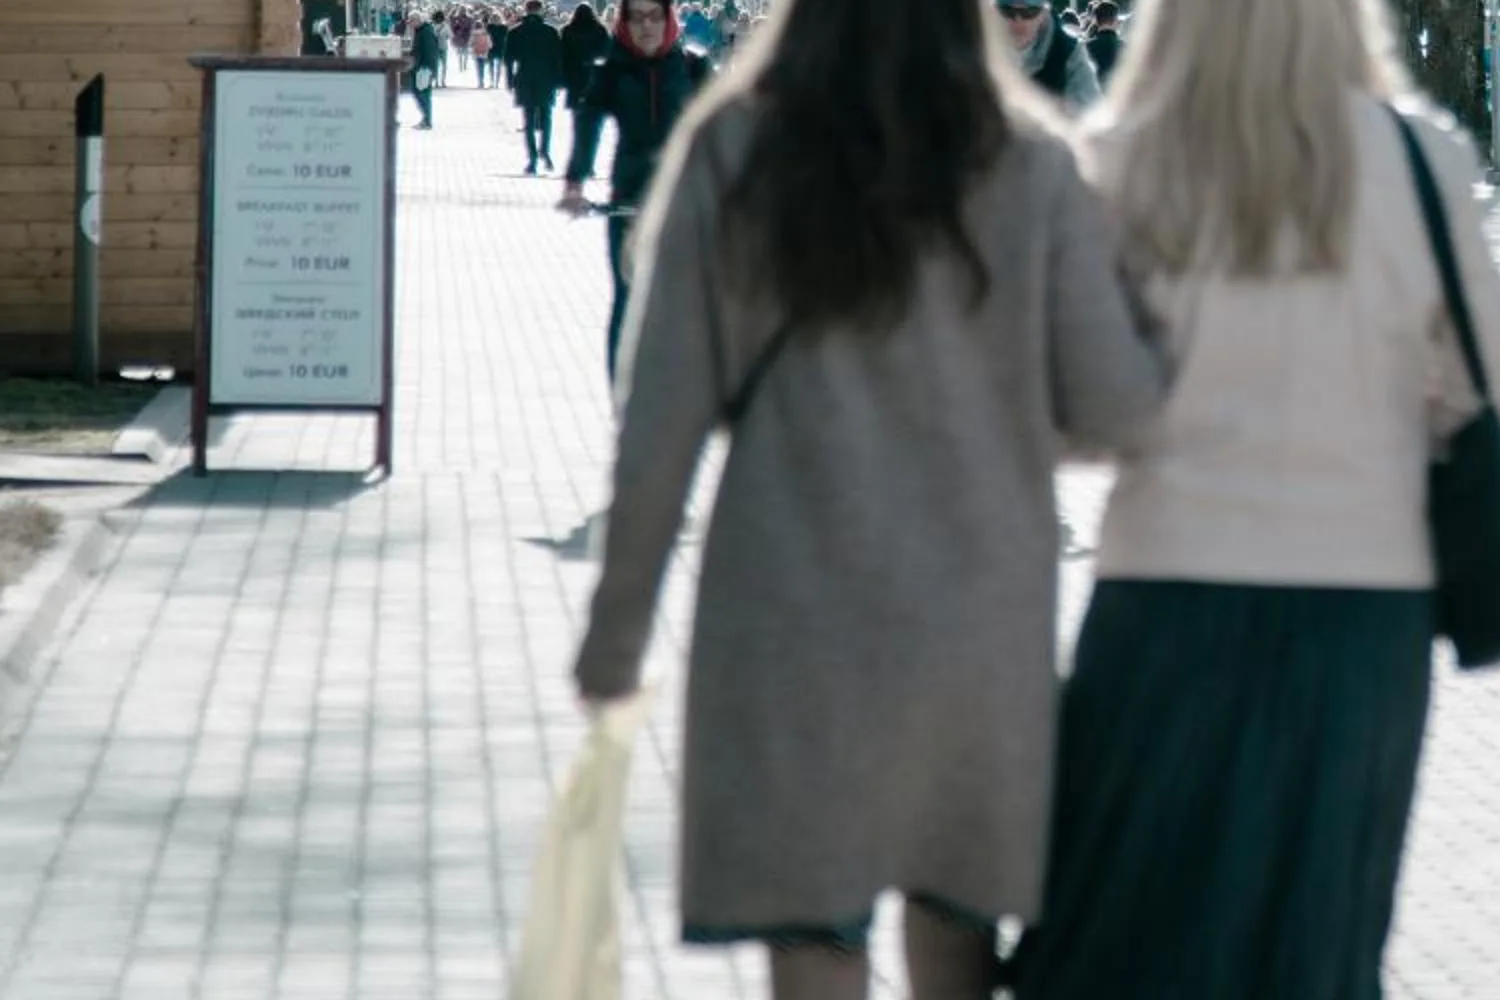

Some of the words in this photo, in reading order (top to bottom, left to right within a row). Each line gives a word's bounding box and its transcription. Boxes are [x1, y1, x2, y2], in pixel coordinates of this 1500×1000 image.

[293, 162, 312, 178] 10
[315, 163, 353, 178] EUR
[291, 255, 310, 270] 10
[314, 255, 351, 270] EUR
[289, 364, 308, 380] 10
[312, 364, 349, 379] EUR
